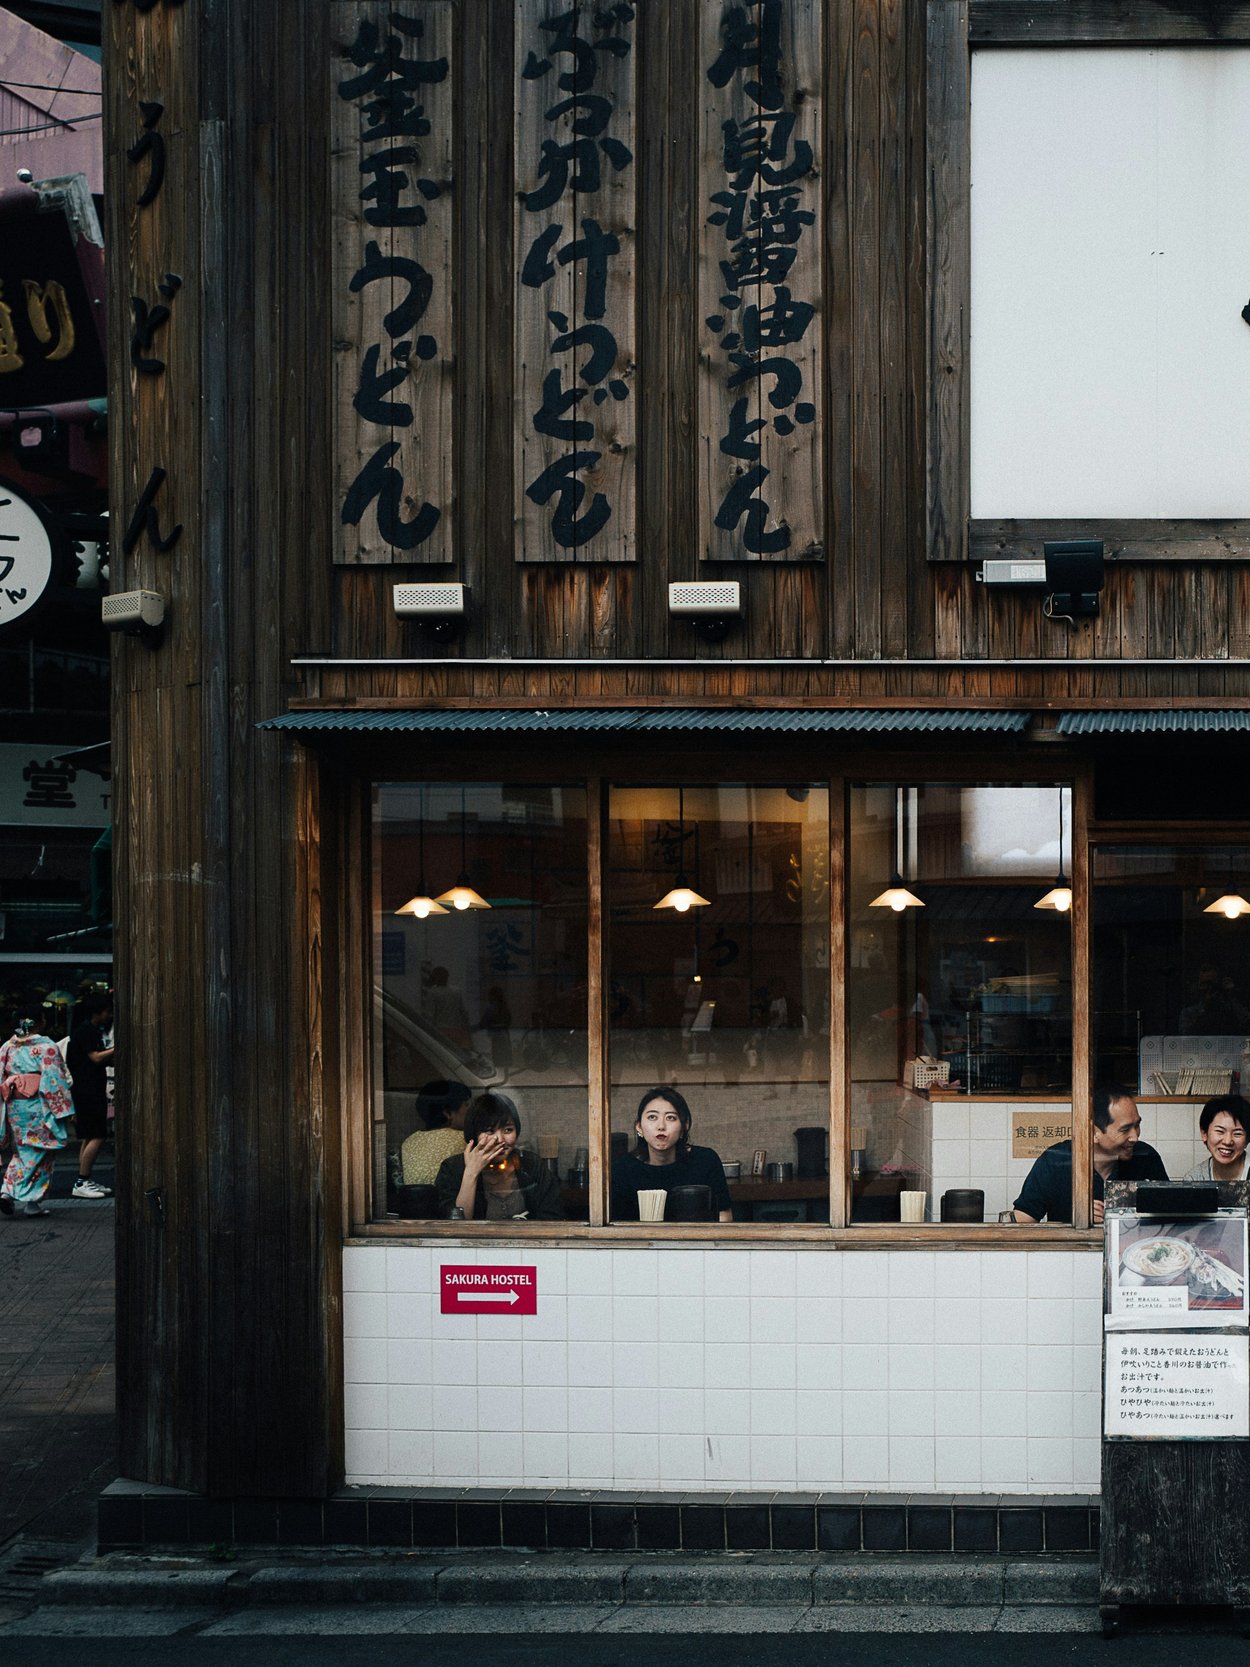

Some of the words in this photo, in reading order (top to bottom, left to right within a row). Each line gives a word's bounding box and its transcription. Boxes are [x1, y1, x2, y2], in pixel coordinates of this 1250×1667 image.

[125, 0, 184, 556] うどん
[338, 12, 450, 551] 釜玉うどん
[706, 0, 817, 556] 月見醤油うどん
[1015, 1125, 1040, 1139] 食器
[445, 1274, 489, 1285] SAKURA
[491, 1274, 532, 1286] HOSTEL
[1120, 1360, 1236, 1369] 伊吹いりこと香川のお醤油で作
